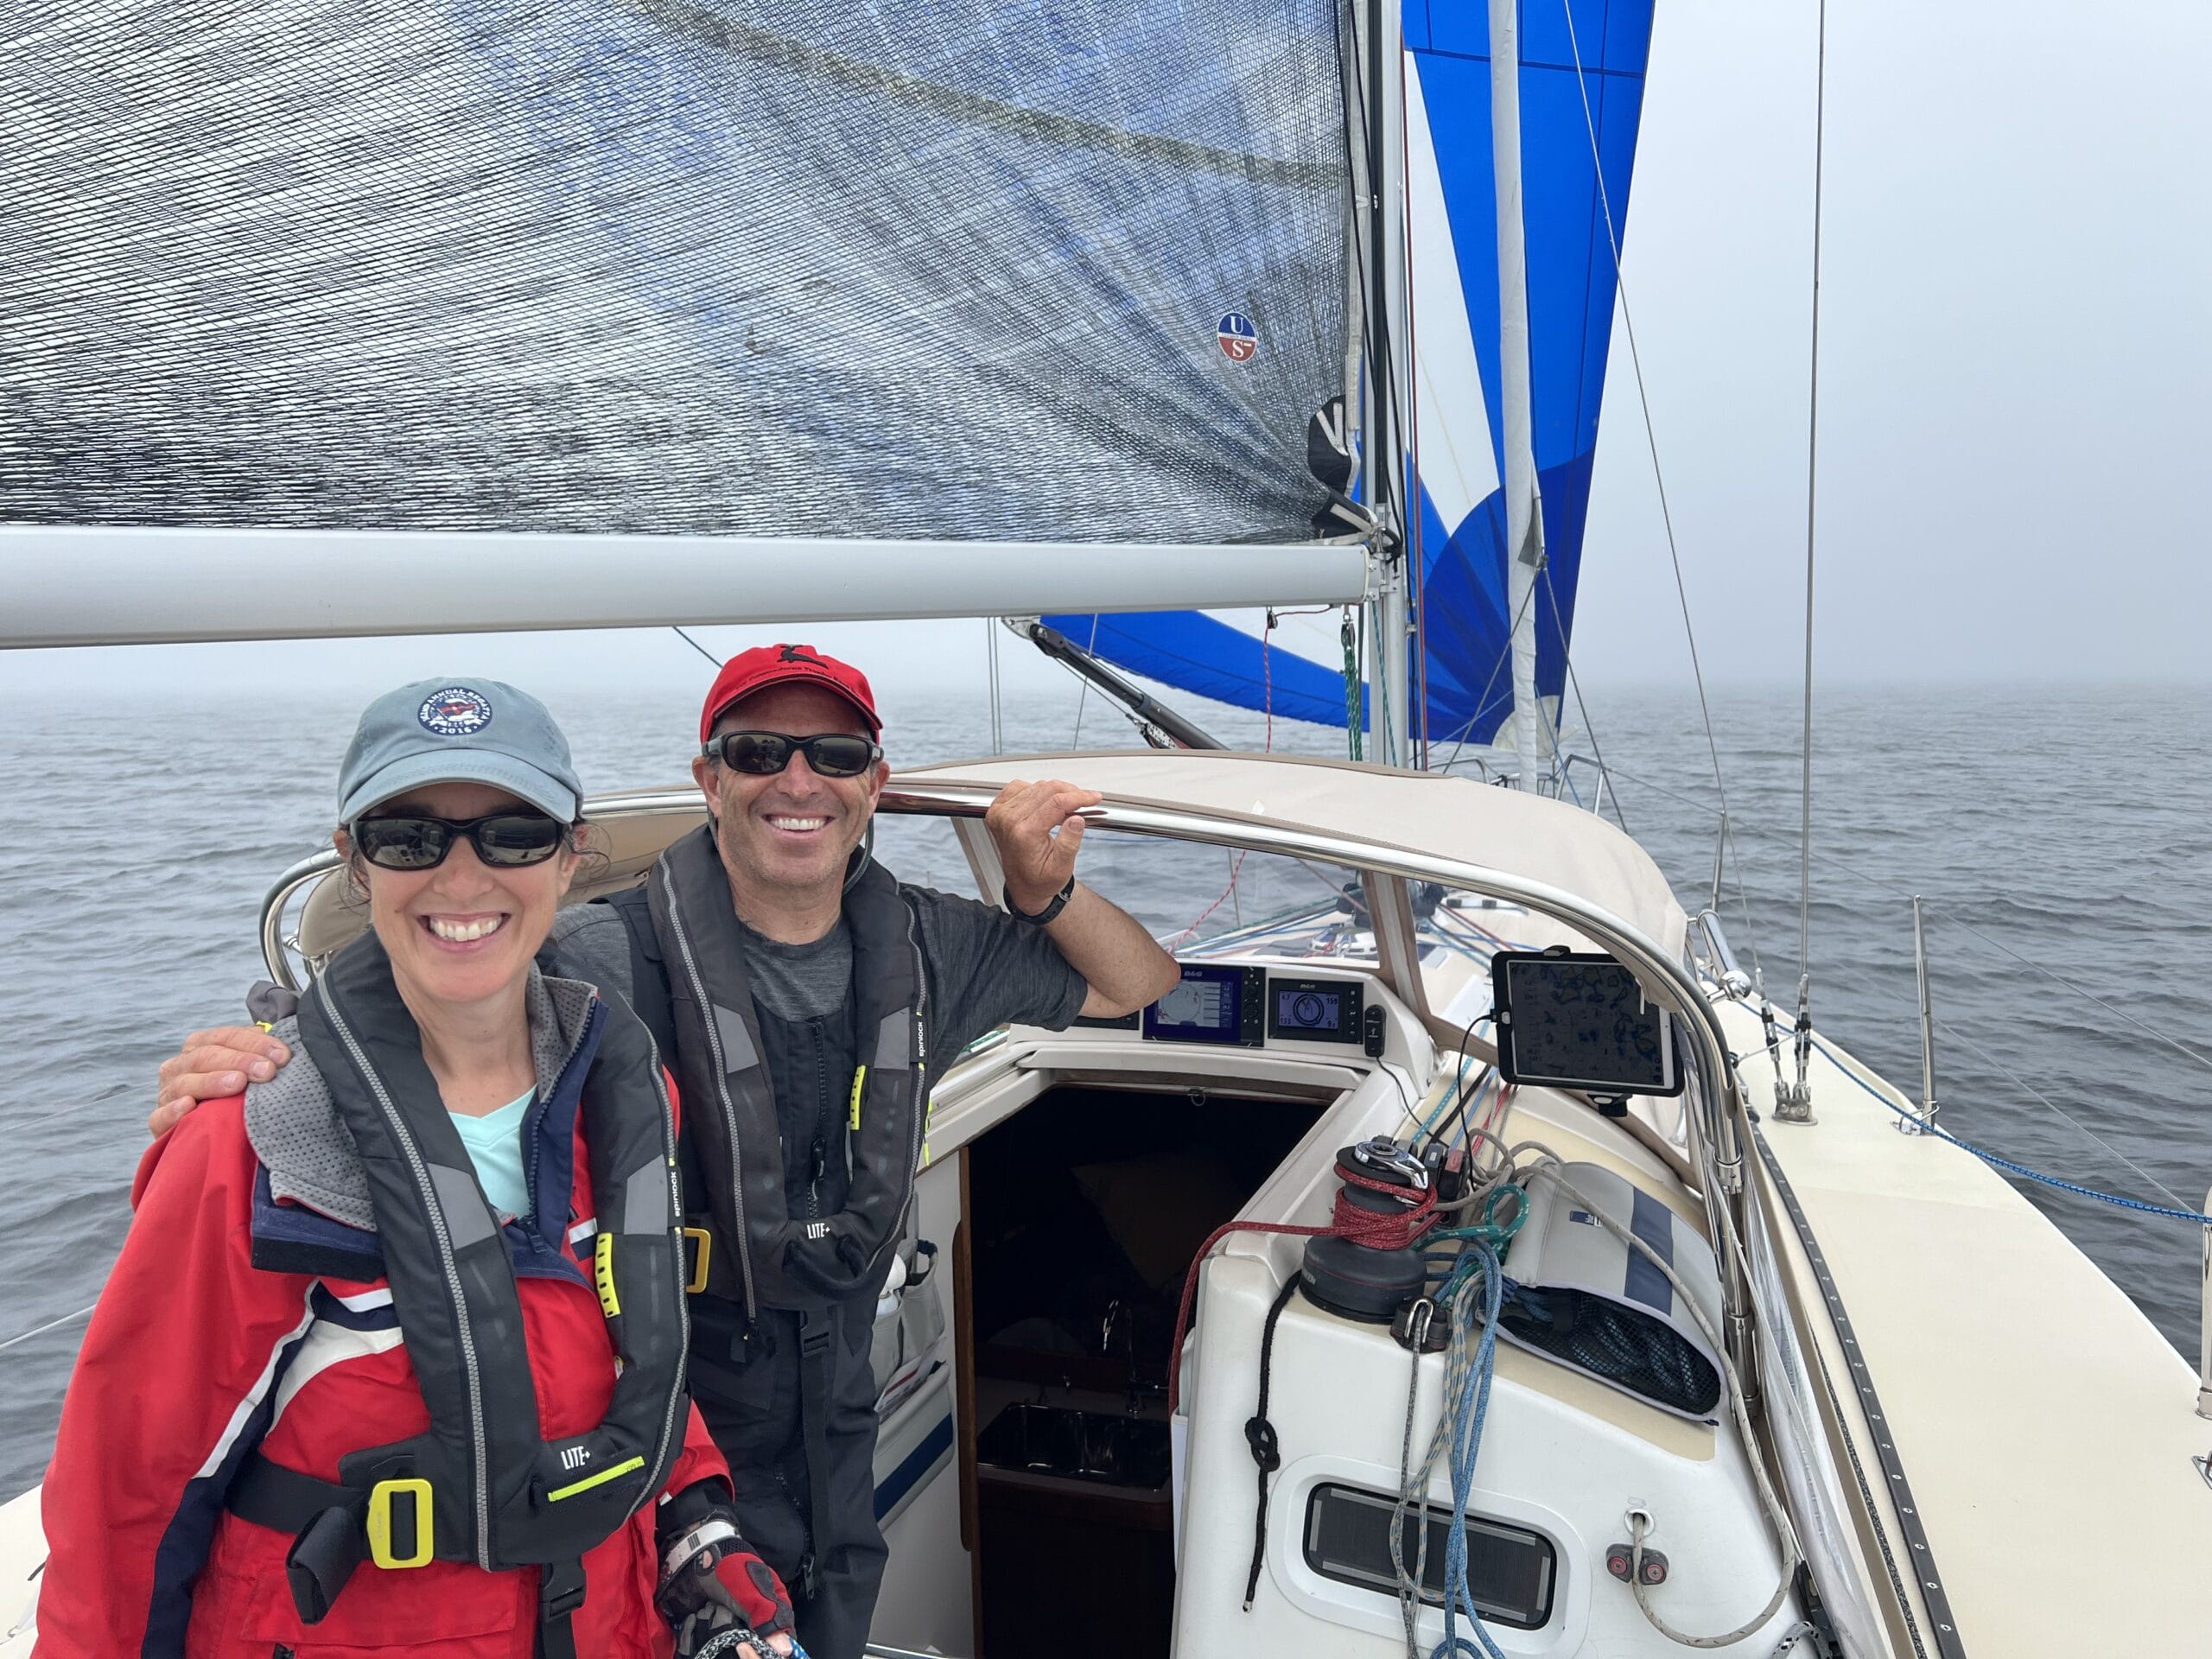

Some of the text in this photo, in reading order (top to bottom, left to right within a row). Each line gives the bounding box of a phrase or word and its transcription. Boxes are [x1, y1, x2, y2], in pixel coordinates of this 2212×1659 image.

[1230, 315, 1244, 334] U
[1232, 340, 1244, 358] S
[427, 689, 466, 704] ANNUAL
[467, 691, 490, 720] REGATTA
[671, 1171, 681, 1217] spinlock
